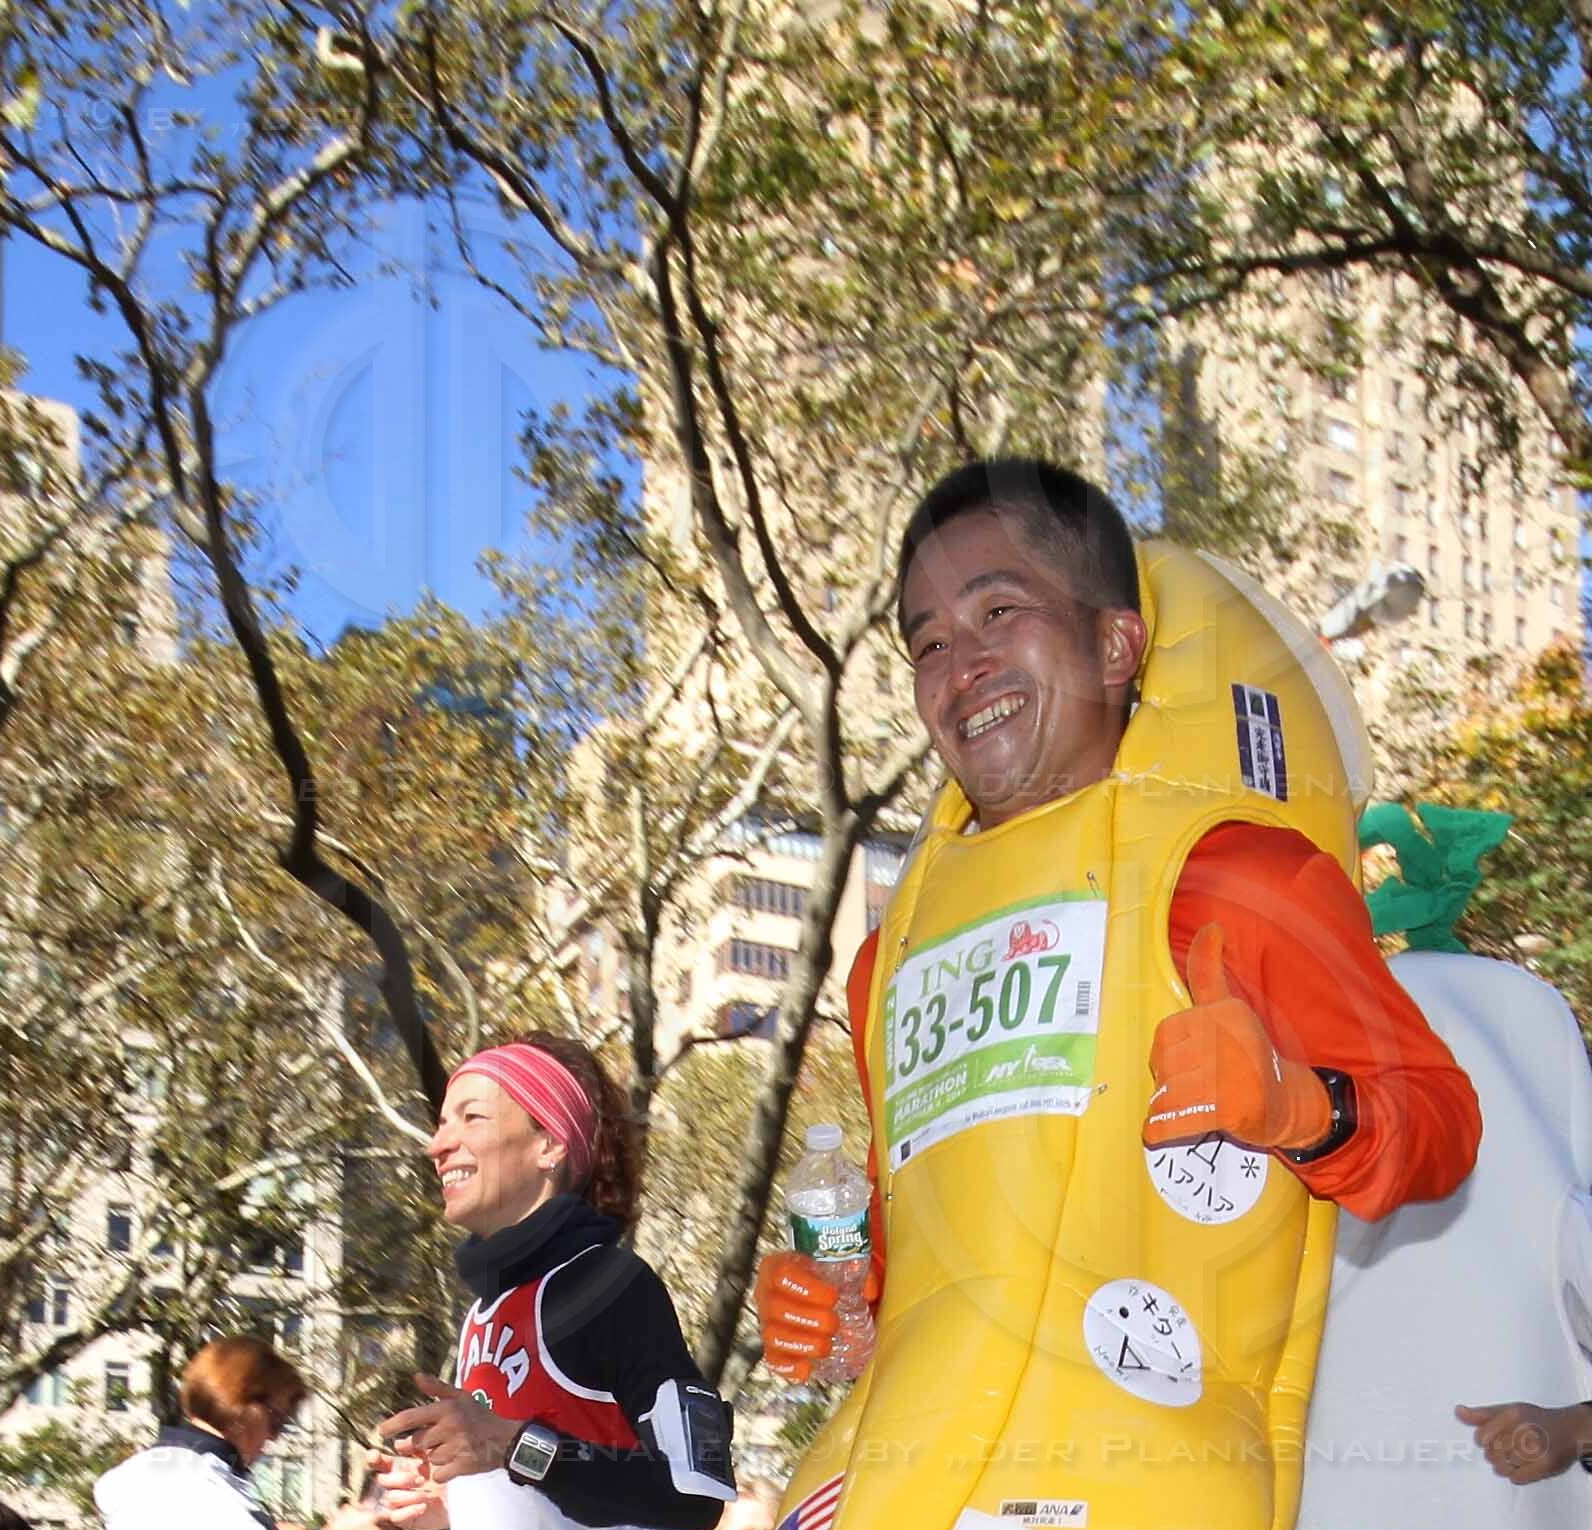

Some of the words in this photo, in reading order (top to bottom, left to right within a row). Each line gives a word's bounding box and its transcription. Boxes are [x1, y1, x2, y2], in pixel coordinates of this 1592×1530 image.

[919, 939, 994, 997] ING
[898, 954, 1071, 1078] 33-507
[818, 1233, 863, 1251] Spring
[1040, 1503, 1068, 1515] ANA
